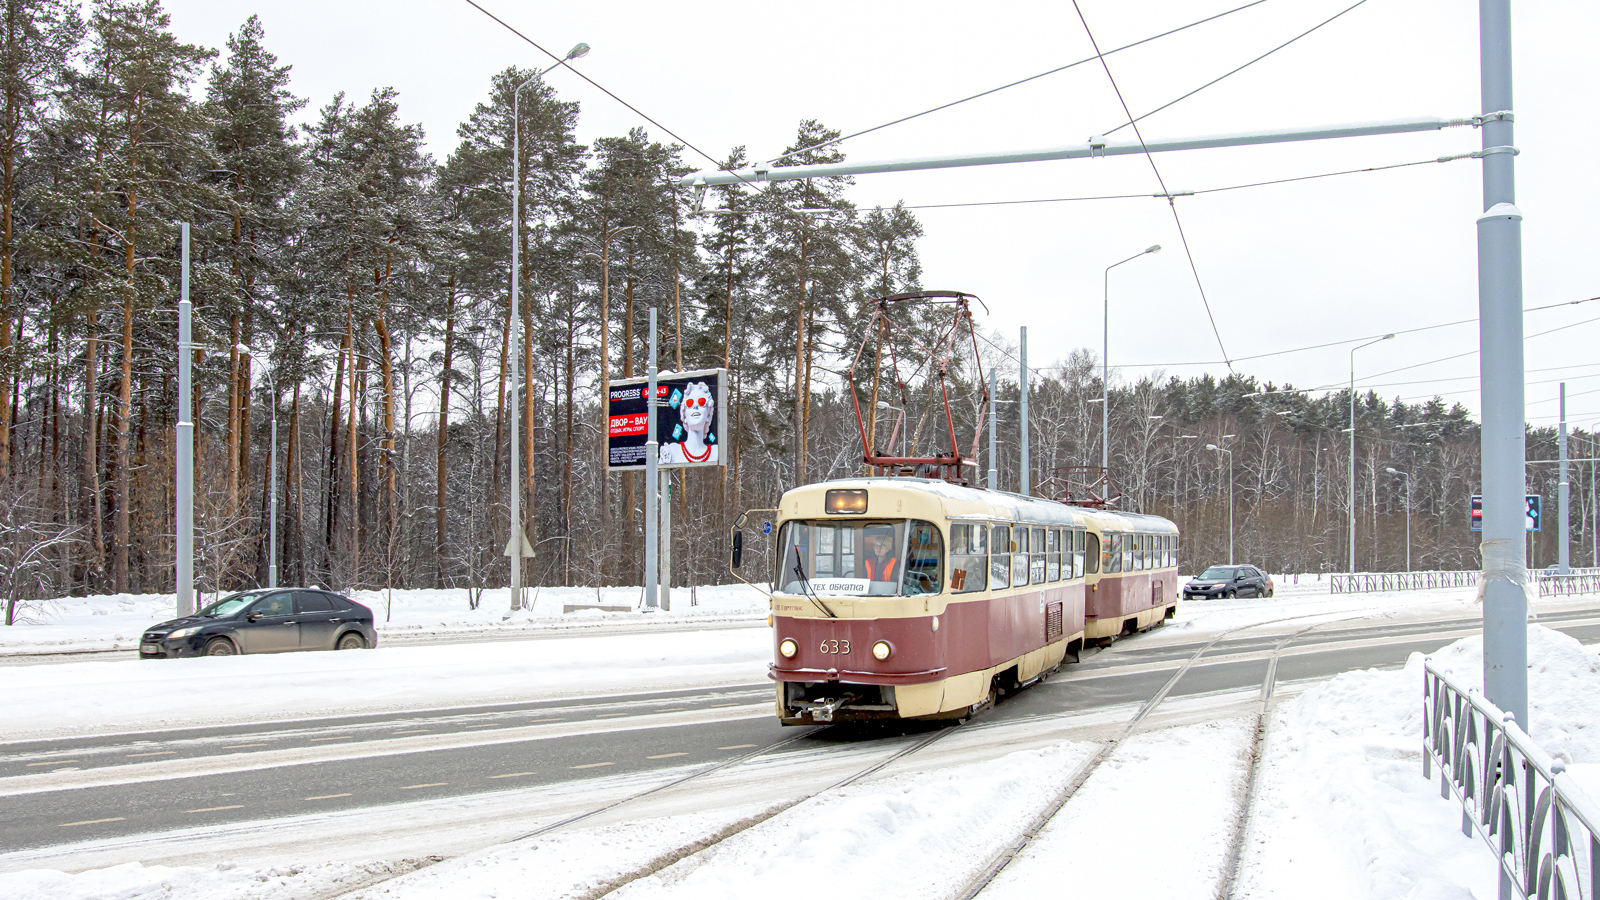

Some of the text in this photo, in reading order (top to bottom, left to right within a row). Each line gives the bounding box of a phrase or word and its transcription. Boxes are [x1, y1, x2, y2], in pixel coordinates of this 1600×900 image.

[610, 388, 640, 398] PROGRESS
[610, 418, 628, 428] ДВОР
[634, 416, 648, 425] ВАУ
[820, 639, 851, 655] 633
